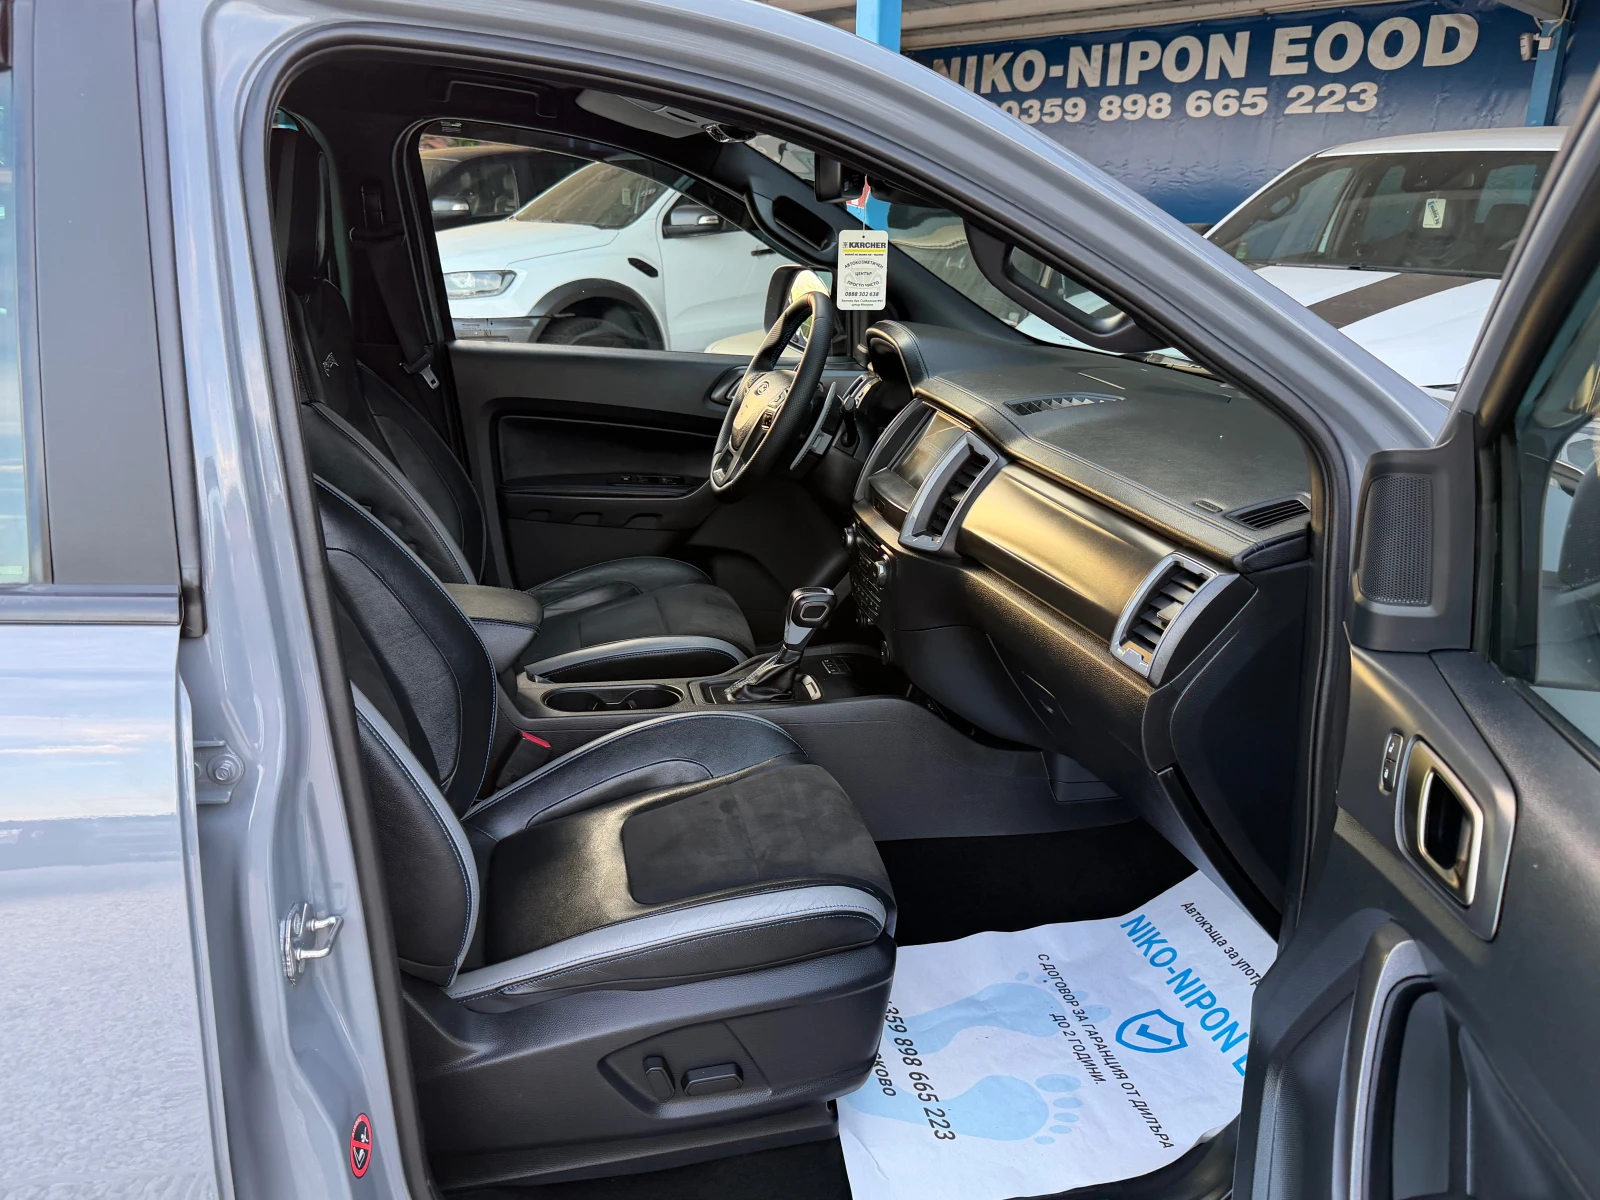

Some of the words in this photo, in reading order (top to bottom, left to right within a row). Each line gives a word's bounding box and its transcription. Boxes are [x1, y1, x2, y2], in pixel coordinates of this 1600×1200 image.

[933, 31, 1250, 94] NIKO-NIPON
[1269, 13, 1479, 76] EOOD
[992, 97, 1086, 124] 0359
[1098, 92, 1172, 122] 898
[1185, 87, 1268, 118] 665
[1284, 81, 1378, 114] 223
[1180, 902, 1227, 947] Автокъща
[1223, 946, 1239, 960] за
[1040, 962, 1080, 1008] ДОГОВОР
[1119, 913, 1249, 1053] NIKO-NIPON
[885, 1001, 908, 1033] 359
[1049, 1013, 1070, 1029] ДО
[1072, 1009, 1089, 1022] ЗА
[893, 1037, 922, 1067] 898
[1082, 1024, 1129, 1080] ГАРАНЦИЯ
[908, 1071, 940, 1103] 665
[1121, 1083, 1141, 1098] ОТ
[923, 1106, 956, 1141] 223
[1128, 1099, 1174, 1149] ДИЛЪРА
